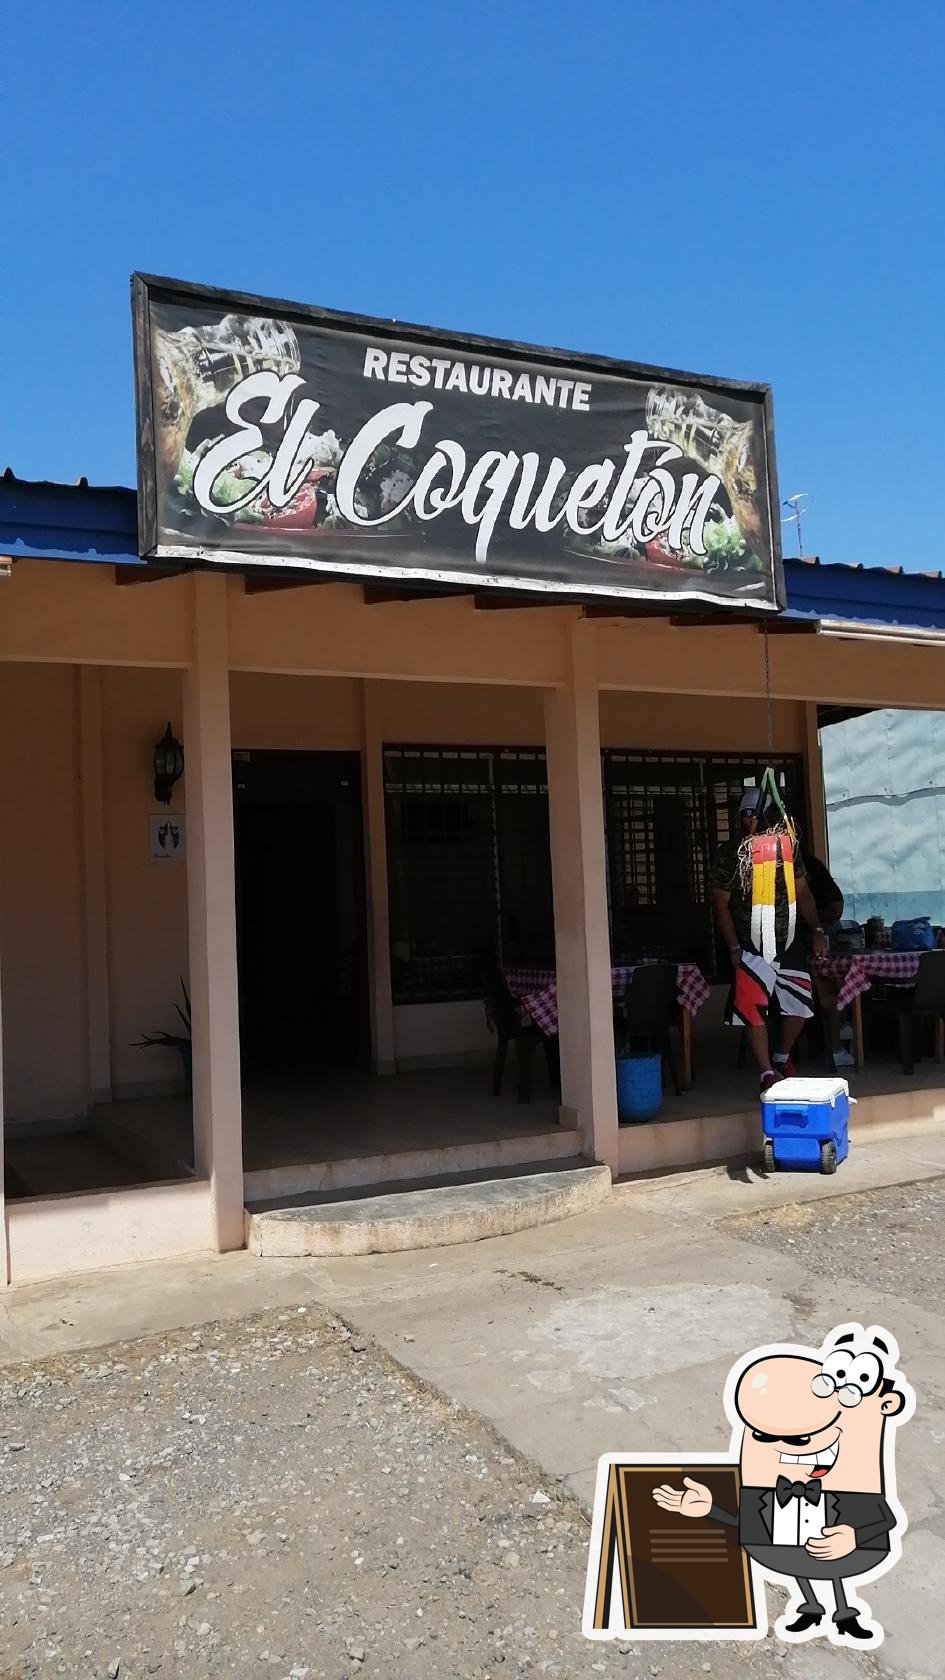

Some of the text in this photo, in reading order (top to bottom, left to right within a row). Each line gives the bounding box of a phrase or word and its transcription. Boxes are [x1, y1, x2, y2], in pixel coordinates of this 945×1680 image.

[363, 347, 592, 412] RESTAURANTE
[193, 371, 721, 564] El Coquetón
